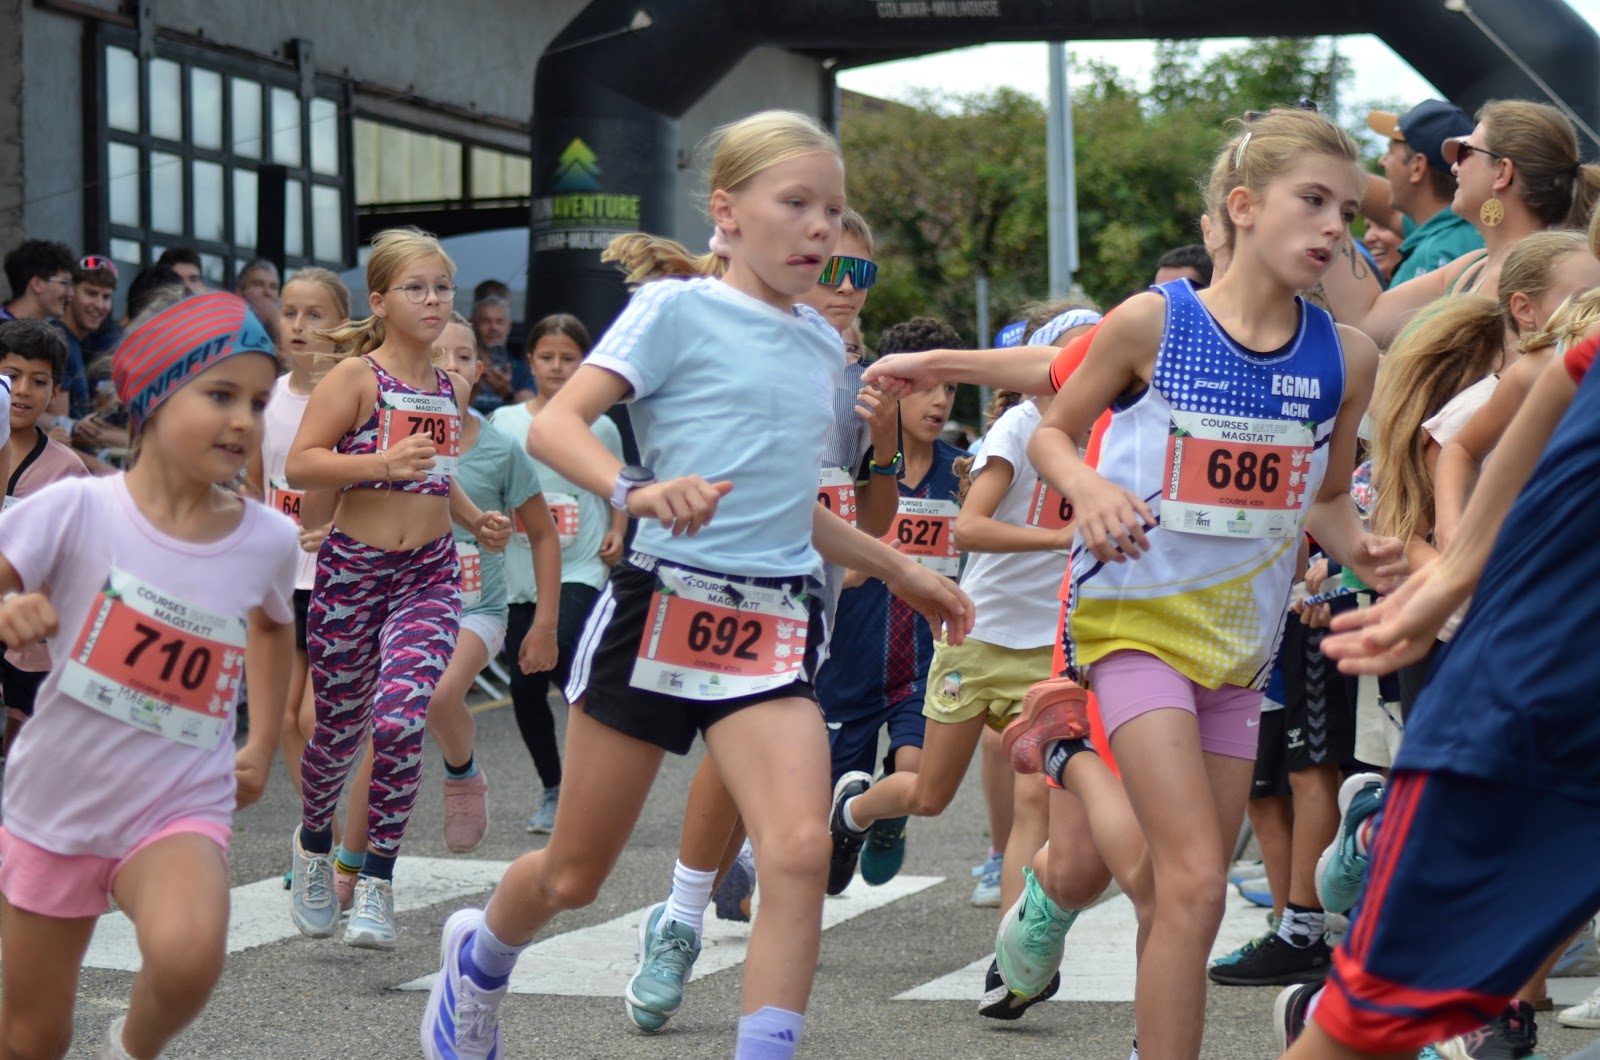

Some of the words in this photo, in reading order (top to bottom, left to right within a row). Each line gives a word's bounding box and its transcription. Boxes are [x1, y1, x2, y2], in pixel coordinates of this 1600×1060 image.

[1193, 379, 1230, 392] poli
[1271, 374, 1321, 400] EGMA
[402, 396, 431, 405] COURSES
[415, 404, 442, 412] MAGSTATT
[1281, 402, 1310, 418] ACIK
[408, 416, 446, 445] 703
[1201, 418, 1249, 431] COURSES
[1221, 431, 1276, 443] MAGSTATT
[1207, 448, 1281, 493] 686
[283, 495, 301, 518] 64
[898, 500, 923, 508] OURSES
[906, 507, 939, 515] MAGSTATT
[898, 518, 943, 546] 627
[137, 586, 188, 616] COURSES
[707, 593, 761, 611] MAGSATT
[153, 607, 214, 637] MAGSTATT
[688, 610, 762, 661] 692
[124, 622, 212, 691] 710
